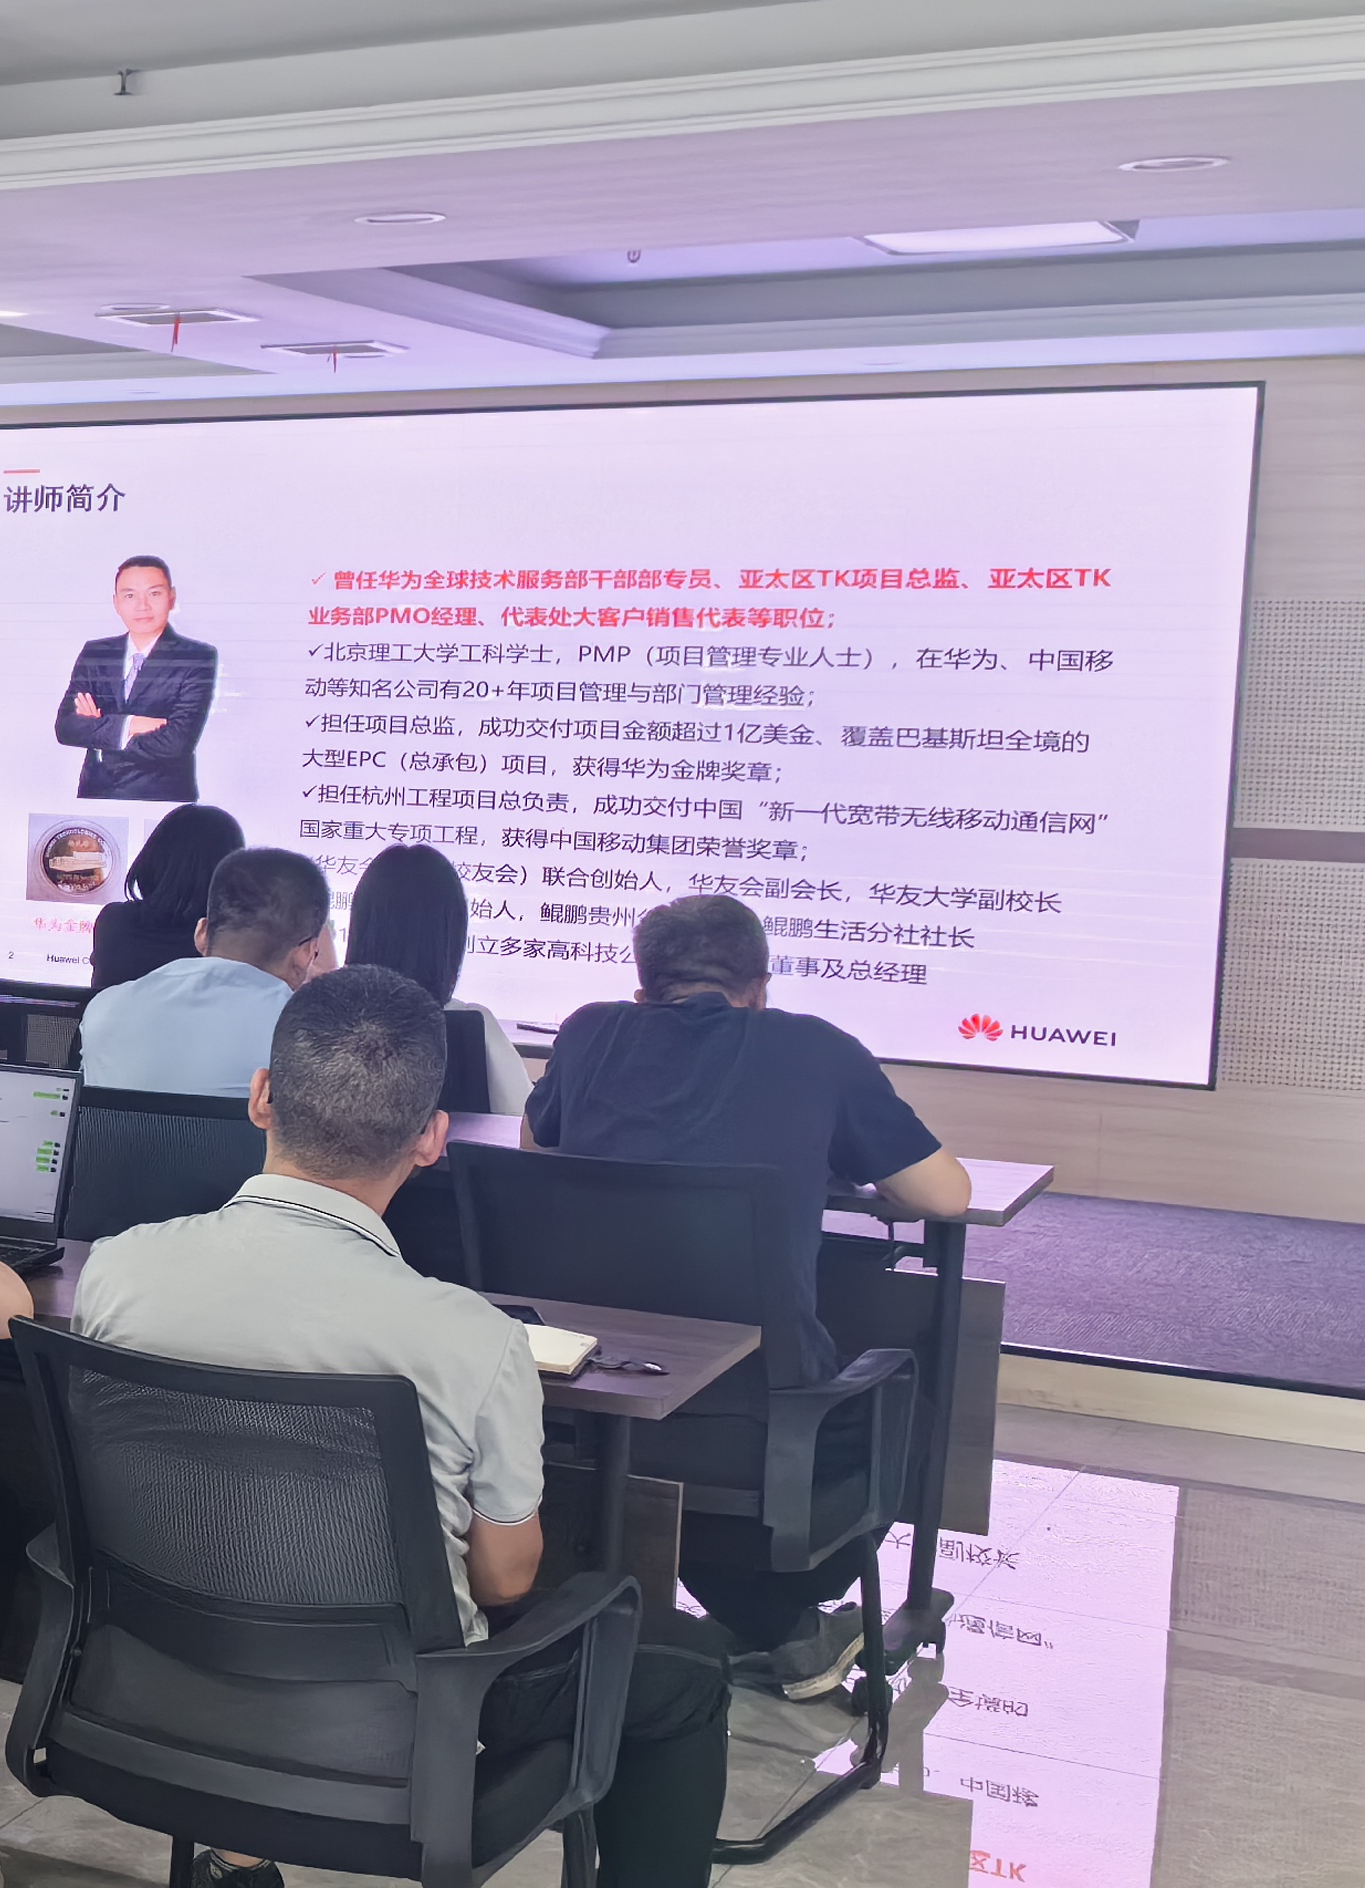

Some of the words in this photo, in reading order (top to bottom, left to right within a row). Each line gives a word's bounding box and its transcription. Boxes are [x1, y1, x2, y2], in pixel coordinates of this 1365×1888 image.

[4, 482, 126, 514] 讲师简介
[300, 819, 808, 861] 国家重大专项工程，获得中国移动集团荣誉奖章；
[469, 897, 645, 928] 始人，鲲鹏贵州
[8, 951, 15, 960] 2
[46, 953, 80, 965] Huawei
[1011, 1024, 1116, 1048] HUAWEI
